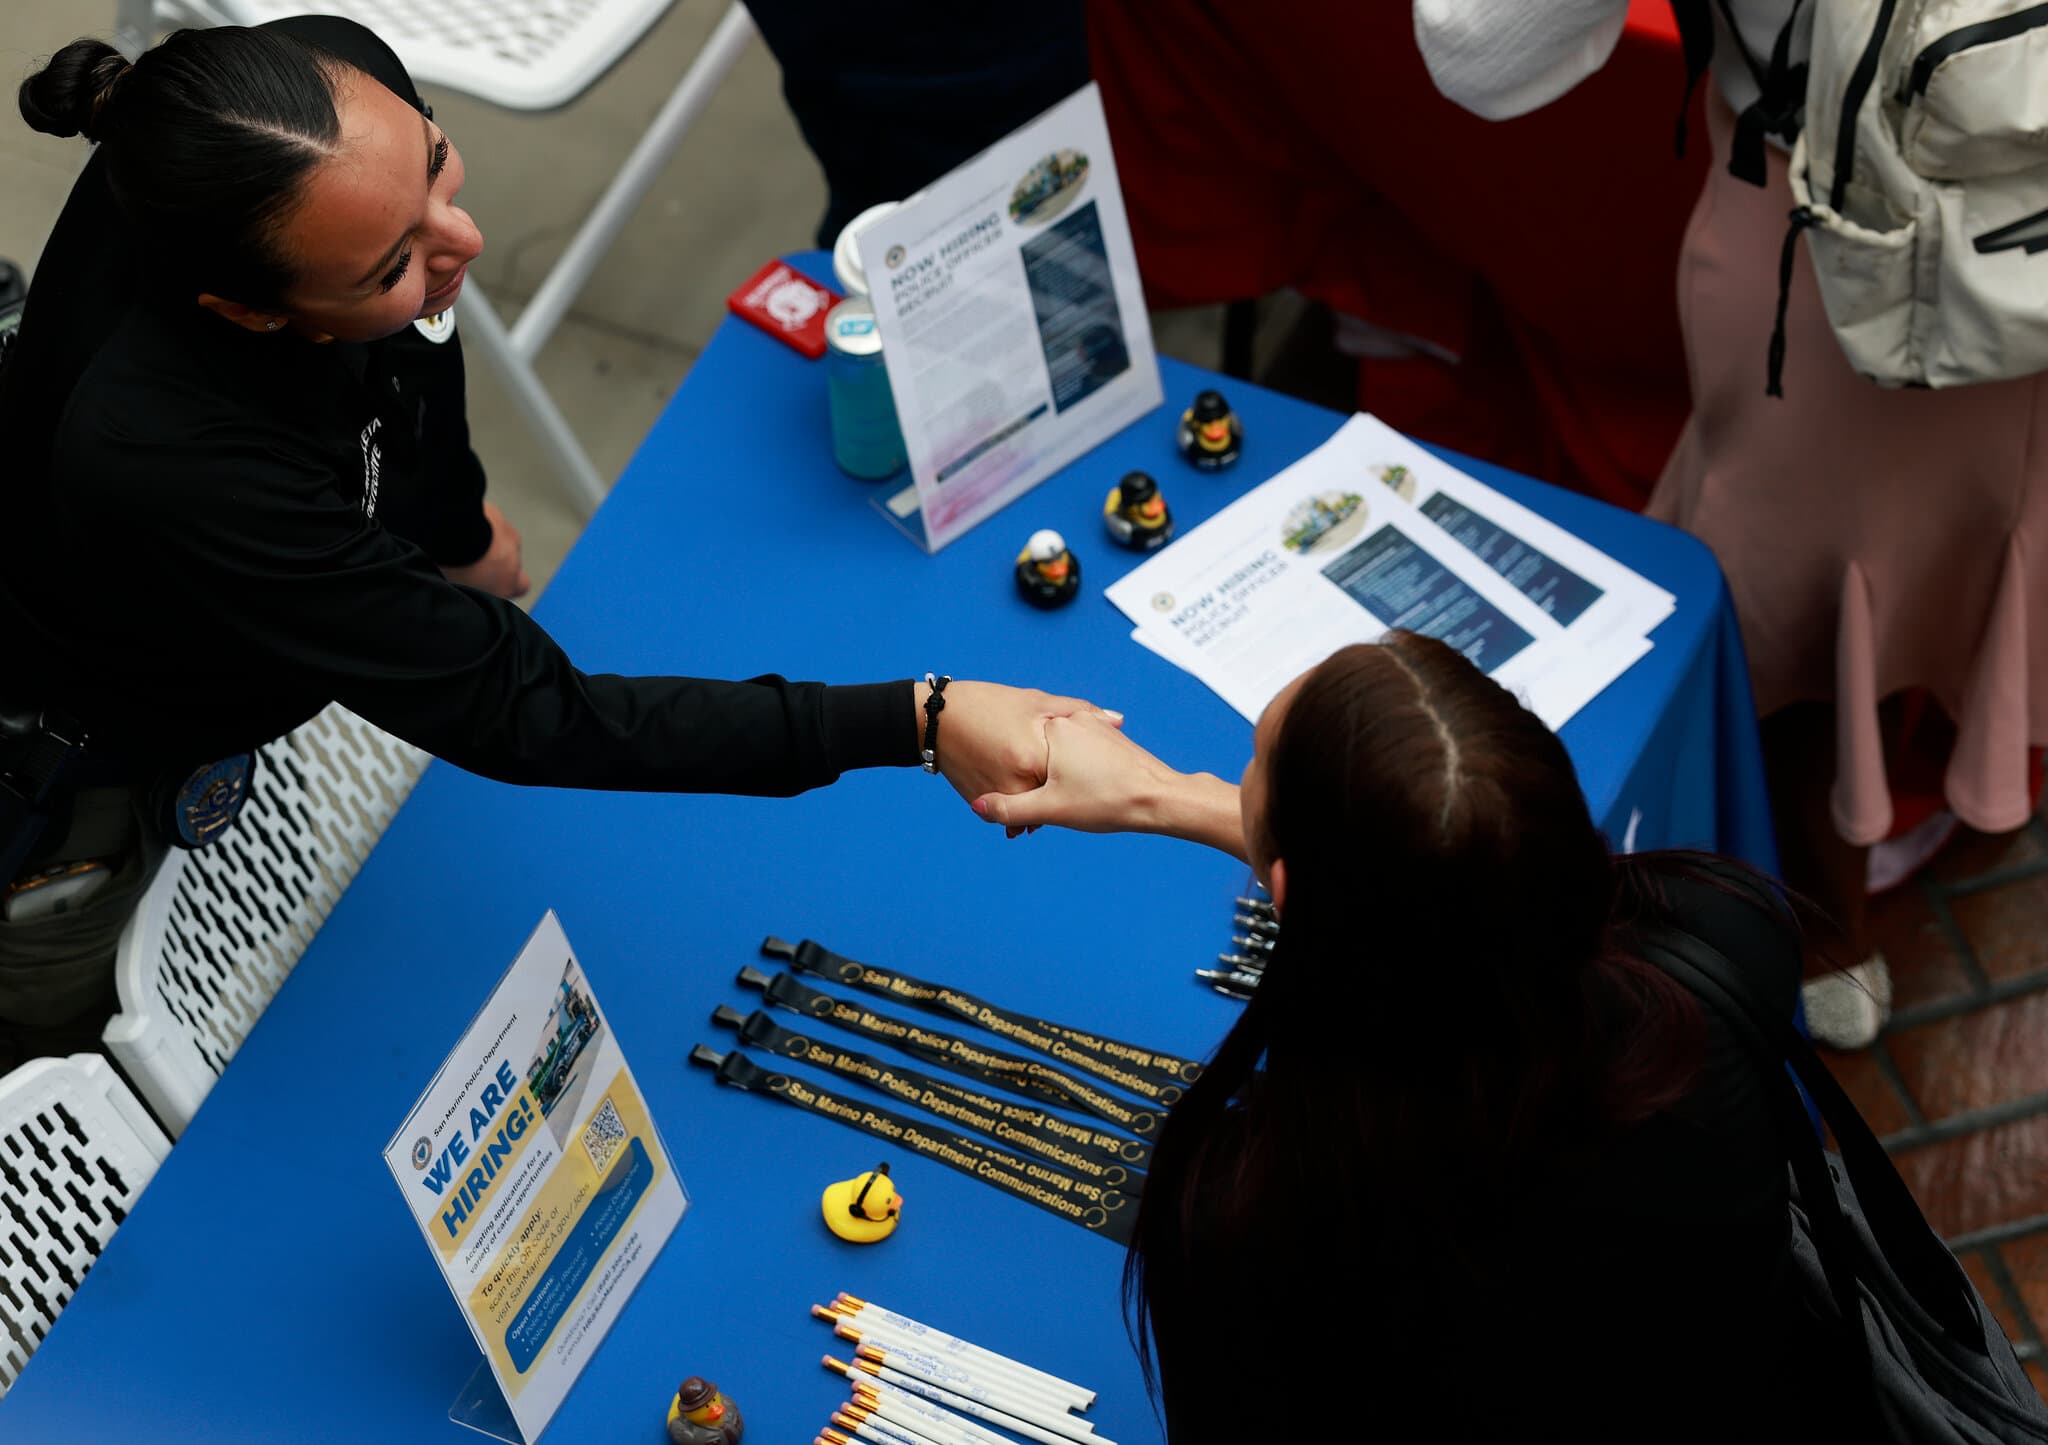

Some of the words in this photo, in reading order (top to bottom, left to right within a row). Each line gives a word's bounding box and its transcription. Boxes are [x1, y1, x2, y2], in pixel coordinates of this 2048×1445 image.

[940, 211, 999, 259] HIRING
[434, 1120, 446, 1137] San
[445, 1090, 466, 1120] Marino
[464, 1064, 483, 1091] Police
[482, 1014, 517, 1064] Department
[833, 1004, 860, 1022] San
[860, 1013, 906, 1037] Marino
[907, 1028, 950, 1049] Police
[951, 1041, 1027, 1070] Department
[1029, 1064, 1133, 1123] Communications
[863, 970, 890, 987] San
[890, 978, 936, 999] Marino
[937, 990, 978, 1016] Police
[977, 1008, 1053, 1050] Department
[1052, 1041, 1158, 1096] Communications
[1153, 1056, 1180, 1074] San
[422, 1130, 470, 1196] WE
[469, 1059, 517, 1142] ARE
[788, 1082, 815, 1104] San
[815, 1095, 861, 1120] Marino
[861, 1112, 902, 1137] Police
[902, 1128, 978, 1169] Department
[977, 1161, 1083, 1216] Communications
[808, 1045, 834, 1064] San
[835, 1054, 880, 1079] Marino
[879, 1072, 920, 1100] Police
[920, 1090, 996, 1131] Department
[996, 1122, 1103, 1176] Communications
[1045, 1119, 1092, 1144] Marino
[1093, 1134, 1120, 1152] San
[442, 1095, 534, 1238] HIRING!
[466, 1220, 494, 1264] Accepting
[494, 1170, 528, 1221] applications
[526, 1156, 536, 1170] for
[470, 1243, 490, 1274] variety
[490, 1232, 496, 1244] of
[496, 1206, 515, 1234] career
[515, 1151, 552, 1206] opportunities
[1074, 1182, 1101, 1201] San
[482, 1281, 492, 1298] To
[492, 1241, 520, 1284] quickly
[519, 1206, 543, 1243] apply:
[489, 1285, 506, 1311] scan
[506, 1263, 520, 1285] this
[520, 1246, 532, 1265] QR
[532, 1218, 550, 1246] code
[550, 1206, 559, 1221] or
[495, 1301, 509, 1323] visit
[511, 1313, 528, 1340] Open
